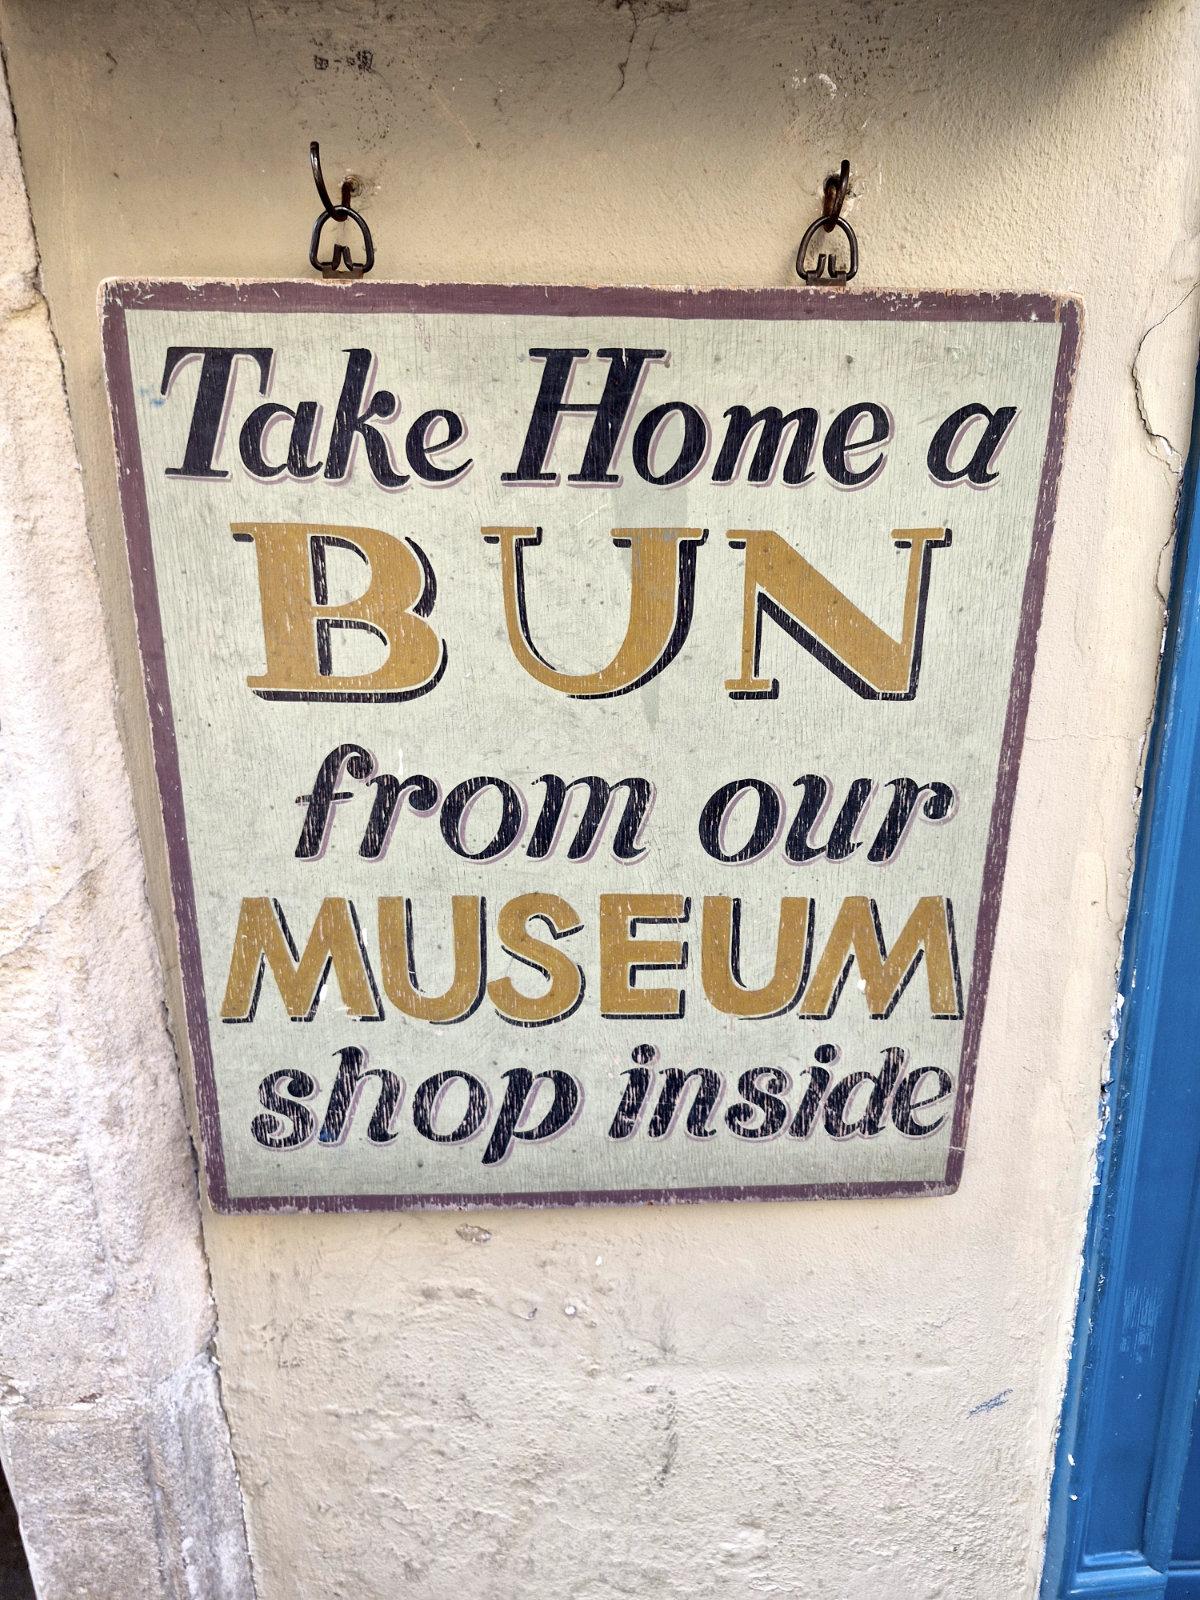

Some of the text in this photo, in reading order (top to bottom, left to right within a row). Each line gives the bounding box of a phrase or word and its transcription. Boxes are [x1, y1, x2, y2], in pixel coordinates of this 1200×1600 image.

[161, 347, 1017, 492] Take Home a
[231, 522, 952, 702] BUN
[295, 744, 958, 863] from our
[222, 892, 962, 1027] MUSEUM
[252, 1043, 959, 1165] shop inside
